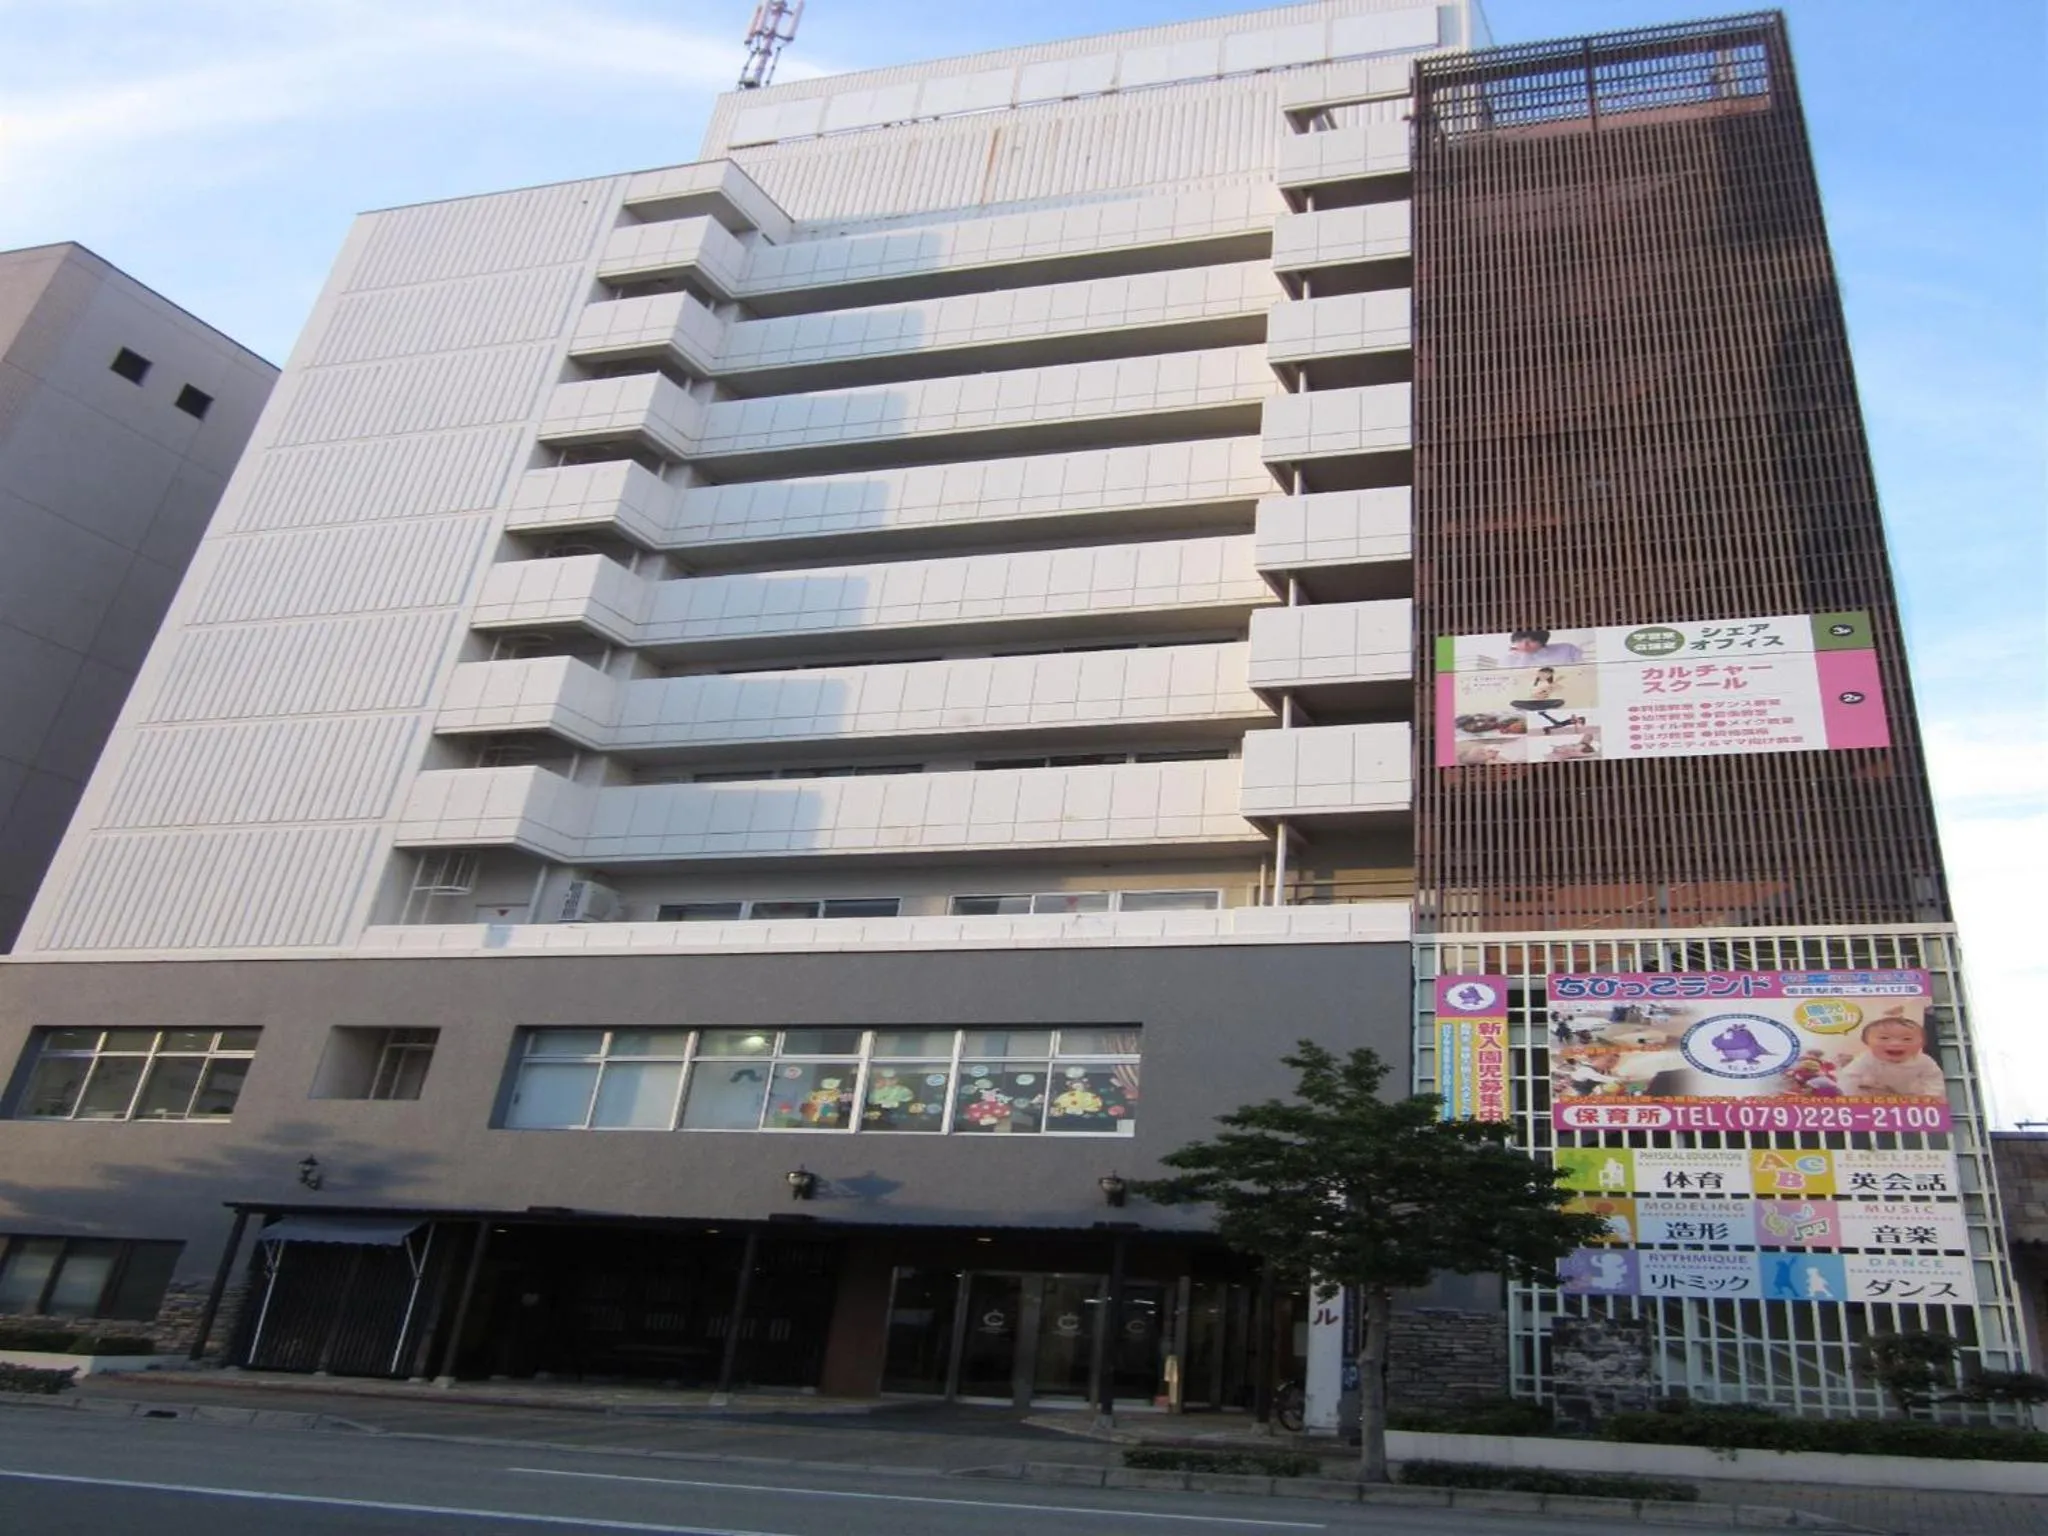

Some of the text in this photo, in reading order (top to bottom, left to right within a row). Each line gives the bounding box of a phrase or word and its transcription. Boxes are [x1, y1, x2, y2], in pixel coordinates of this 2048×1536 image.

[1701, 623, 1771, 637] シェア
[1690, 635, 1784, 650] オフィス
[1641, 664, 1773, 681] カルチャー
[1642, 677, 1748, 694] スクール
[1555, 975, 1771, 997] ちびっこランド
[1575, 1108, 1662, 1124] 保育所
[1845, 1153, 1941, 1162] ENGLISH
[1663, 1171, 1724, 1189] 体育
[1850, 1172, 1948, 1192] 英会話
[1643, 1202, 1745, 1212] MODELING
[1864, 1204, 1935, 1214] MUSIC
[1665, 1221, 1729, 1241] 造形
[1874, 1225, 1938, 1244] 音楽
[1648, 1254, 1749, 1265] RYTHMIQUE
[1868, 1257, 1945, 1268] DANCE
[1651, 1274, 1749, 1291] リトミック
[1864, 1278, 1959, 1298] ダンス
[1313, 1308, 1339, 1326] ル
